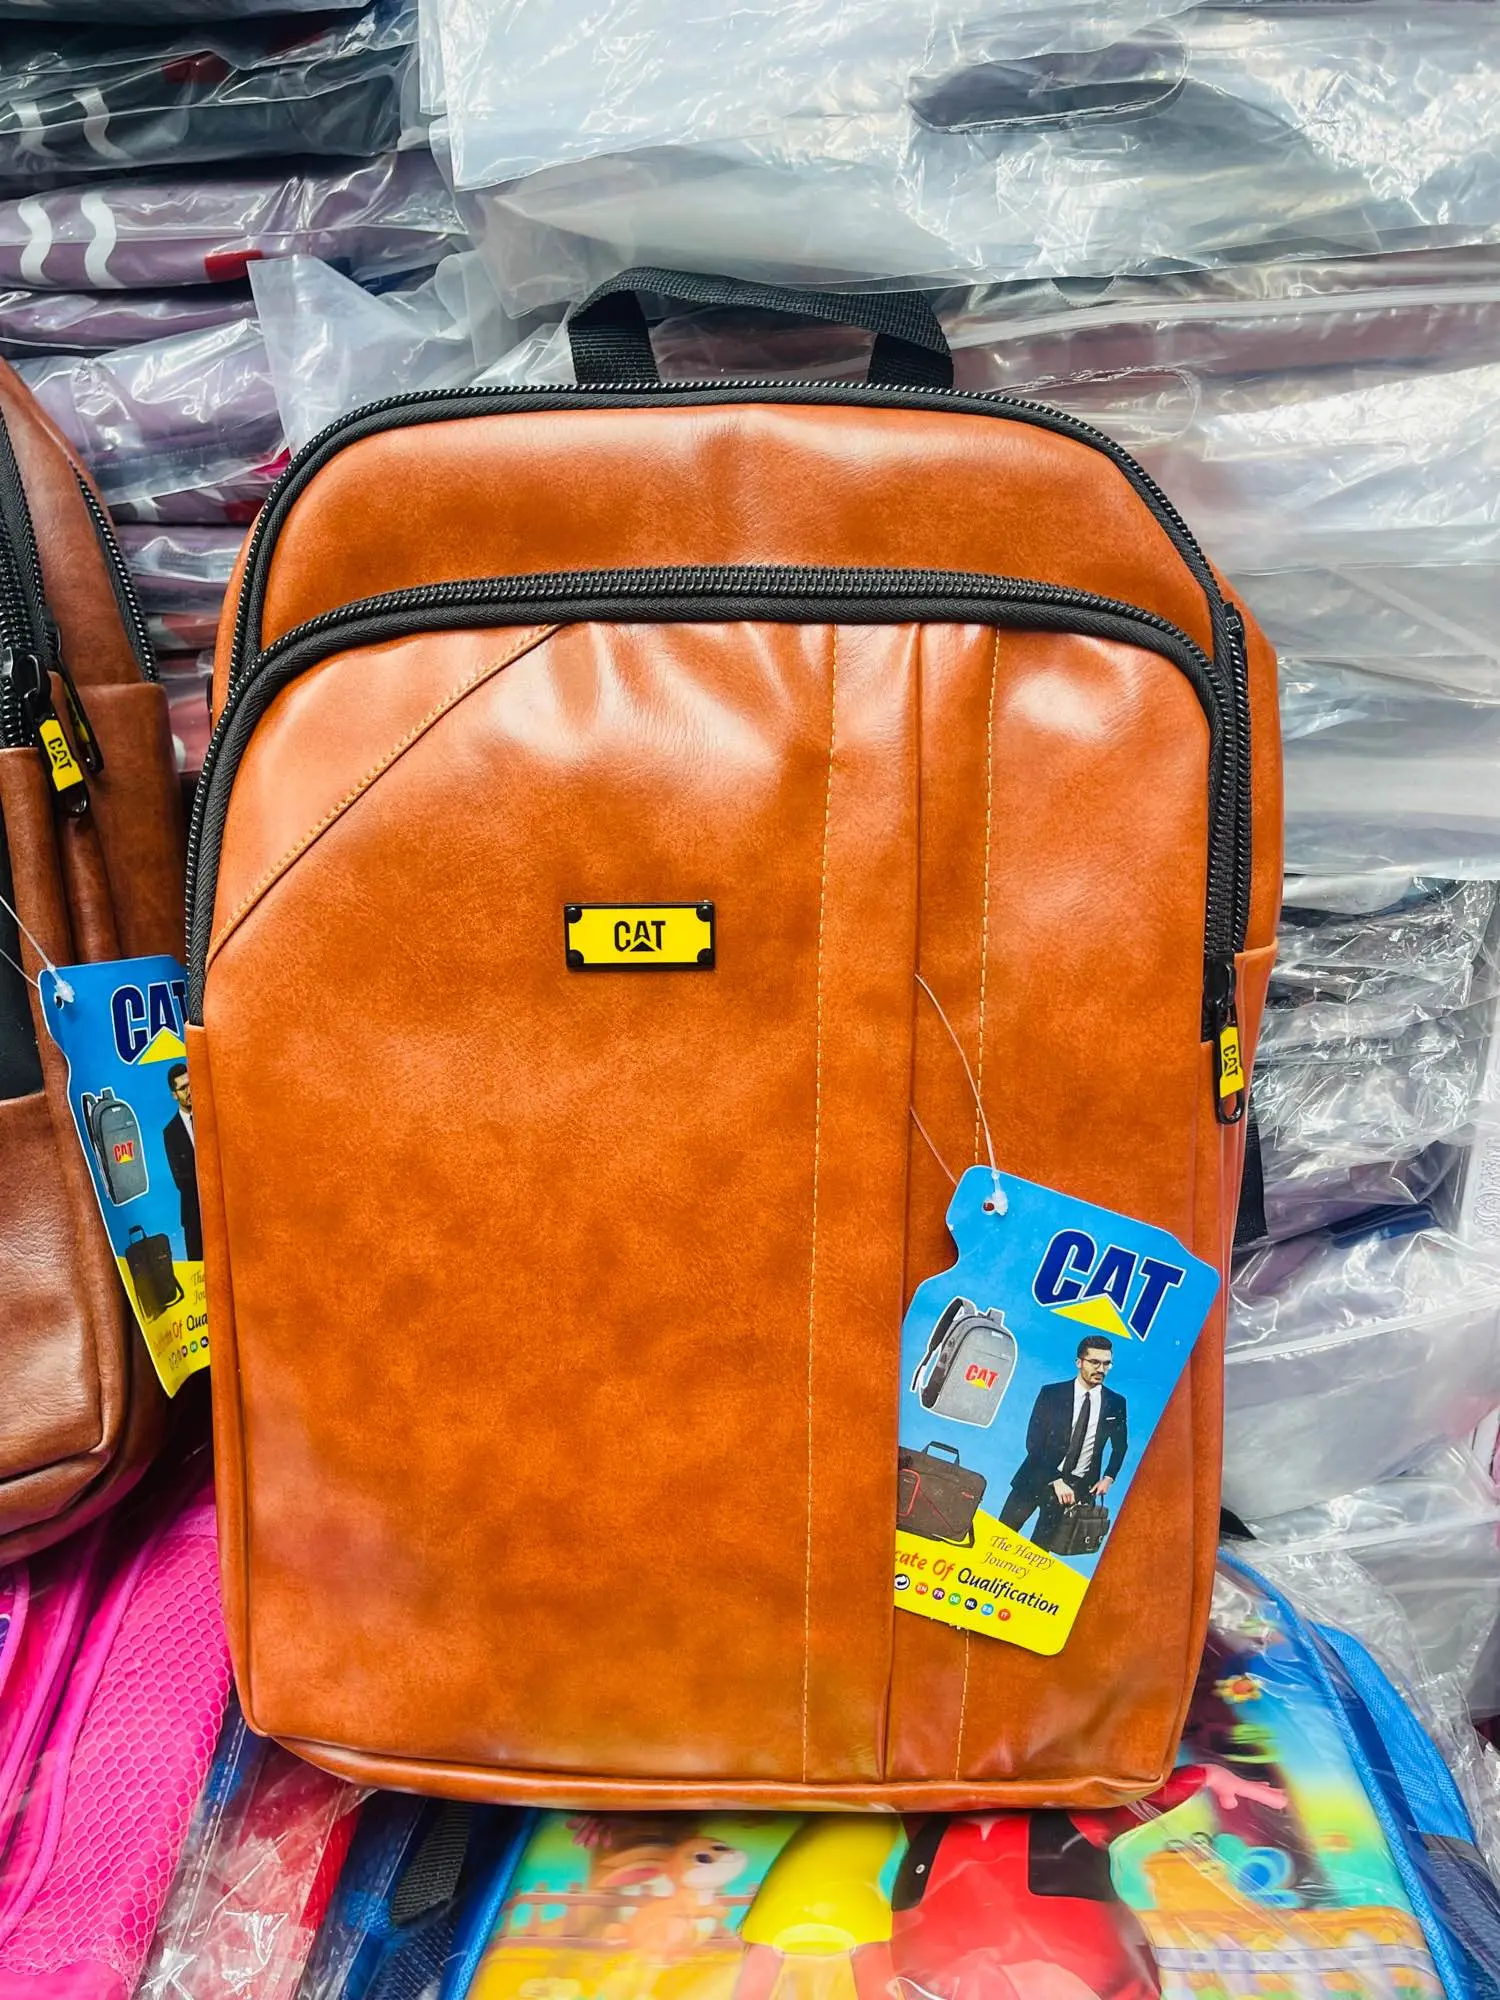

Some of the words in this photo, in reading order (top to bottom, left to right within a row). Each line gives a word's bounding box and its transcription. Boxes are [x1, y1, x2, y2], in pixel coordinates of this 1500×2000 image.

[47, 737, 73, 771] CAT
[614, 920, 666, 952] CAT
[111, 979, 189, 1065] CAT
[1222, 1044, 1239, 1077] CAT
[113, 1141, 134, 1162] CAT
[1032, 1228, 1187, 1342] CAT
[965, 1364, 999, 1390] CAT
[981, 1551, 1030, 1579] Journey
[990, 1535, 1012, 1552] The
[1013, 1544, 1055, 1570] Happy
[932, 1558, 956, 1582] Of
[957, 1567, 1060, 1616] Qualification
[933, 1589, 944, 1599] FR
[966, 1599, 977, 1609] NL
